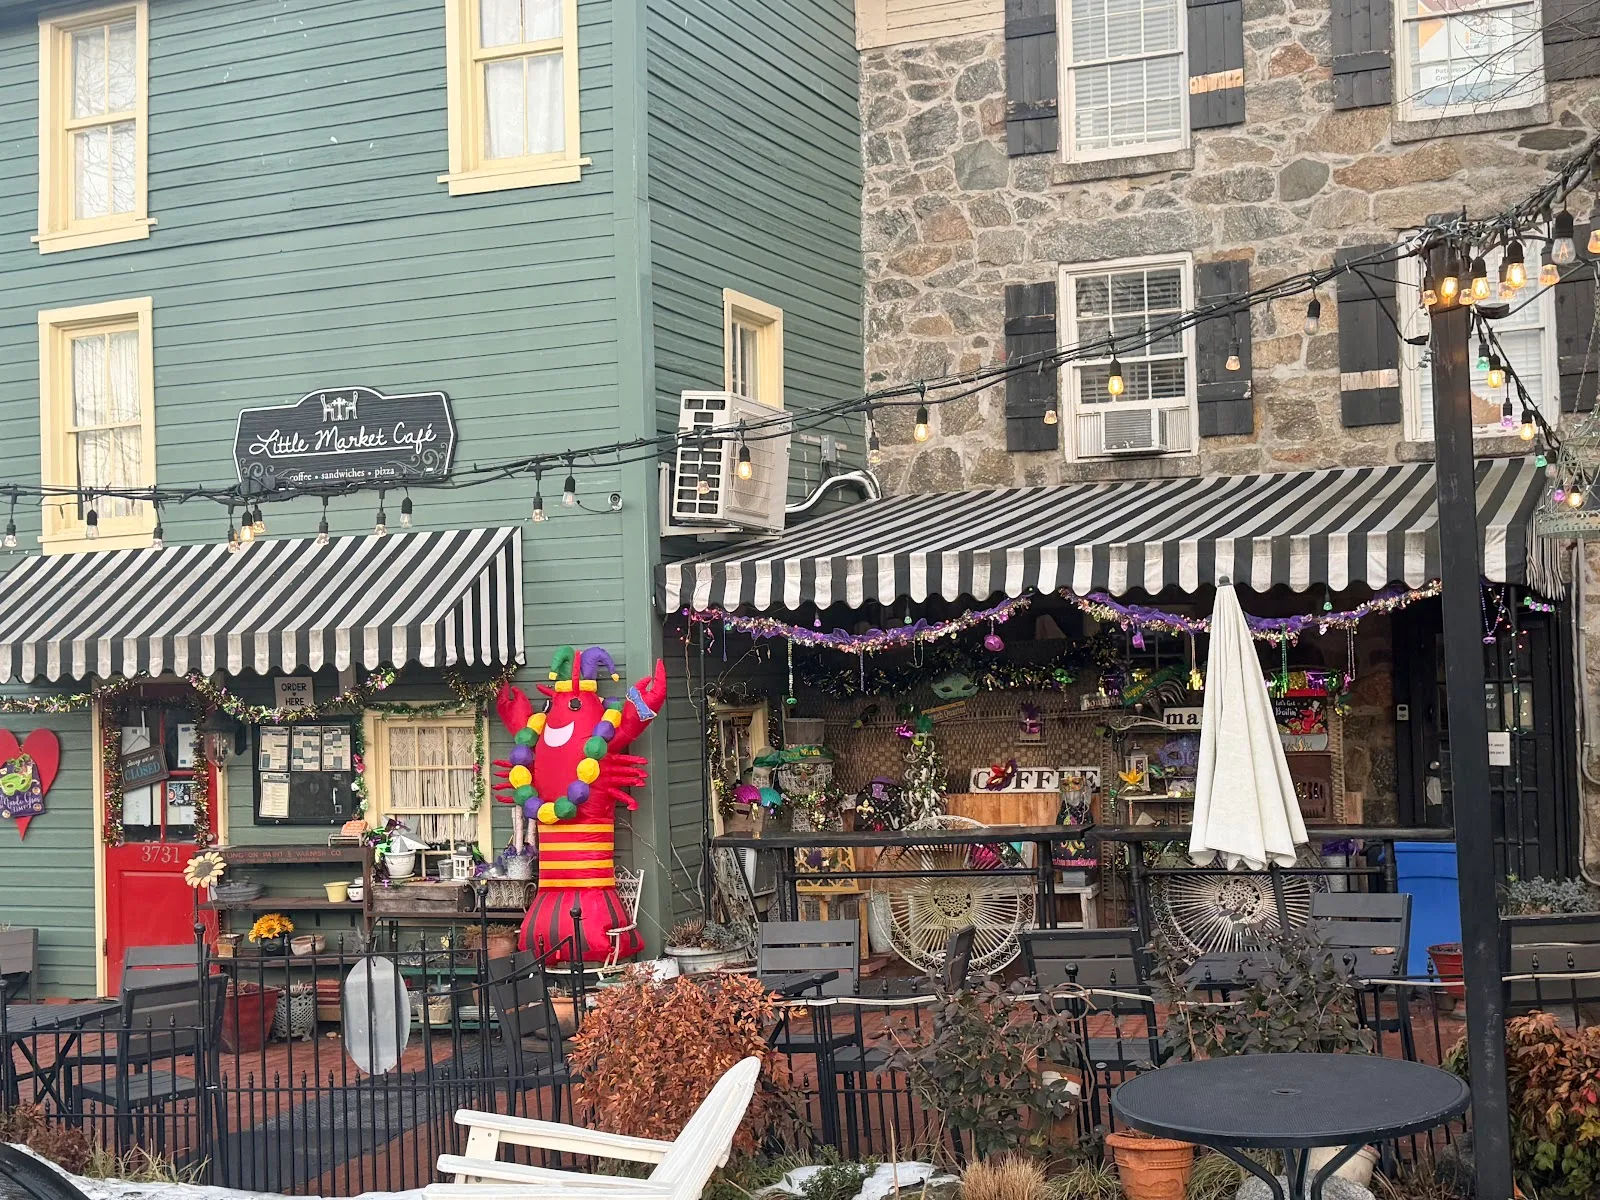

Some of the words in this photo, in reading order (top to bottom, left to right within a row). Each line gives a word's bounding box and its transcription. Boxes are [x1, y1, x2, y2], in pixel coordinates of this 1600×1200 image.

[249, 429, 309, 456] Little
[315, 425, 388, 452] Market
[393, 421, 437, 454] Café
[321, 468, 365, 480] sandwiches
[374, 466, 395, 478] pizza
[281, 682, 307, 692] ORDER
[285, 697, 305, 706] HERE
[1164, 711, 1202, 725] ma
[124, 761, 161, 781] CLOSED
[141, 845, 180, 864] 3731
